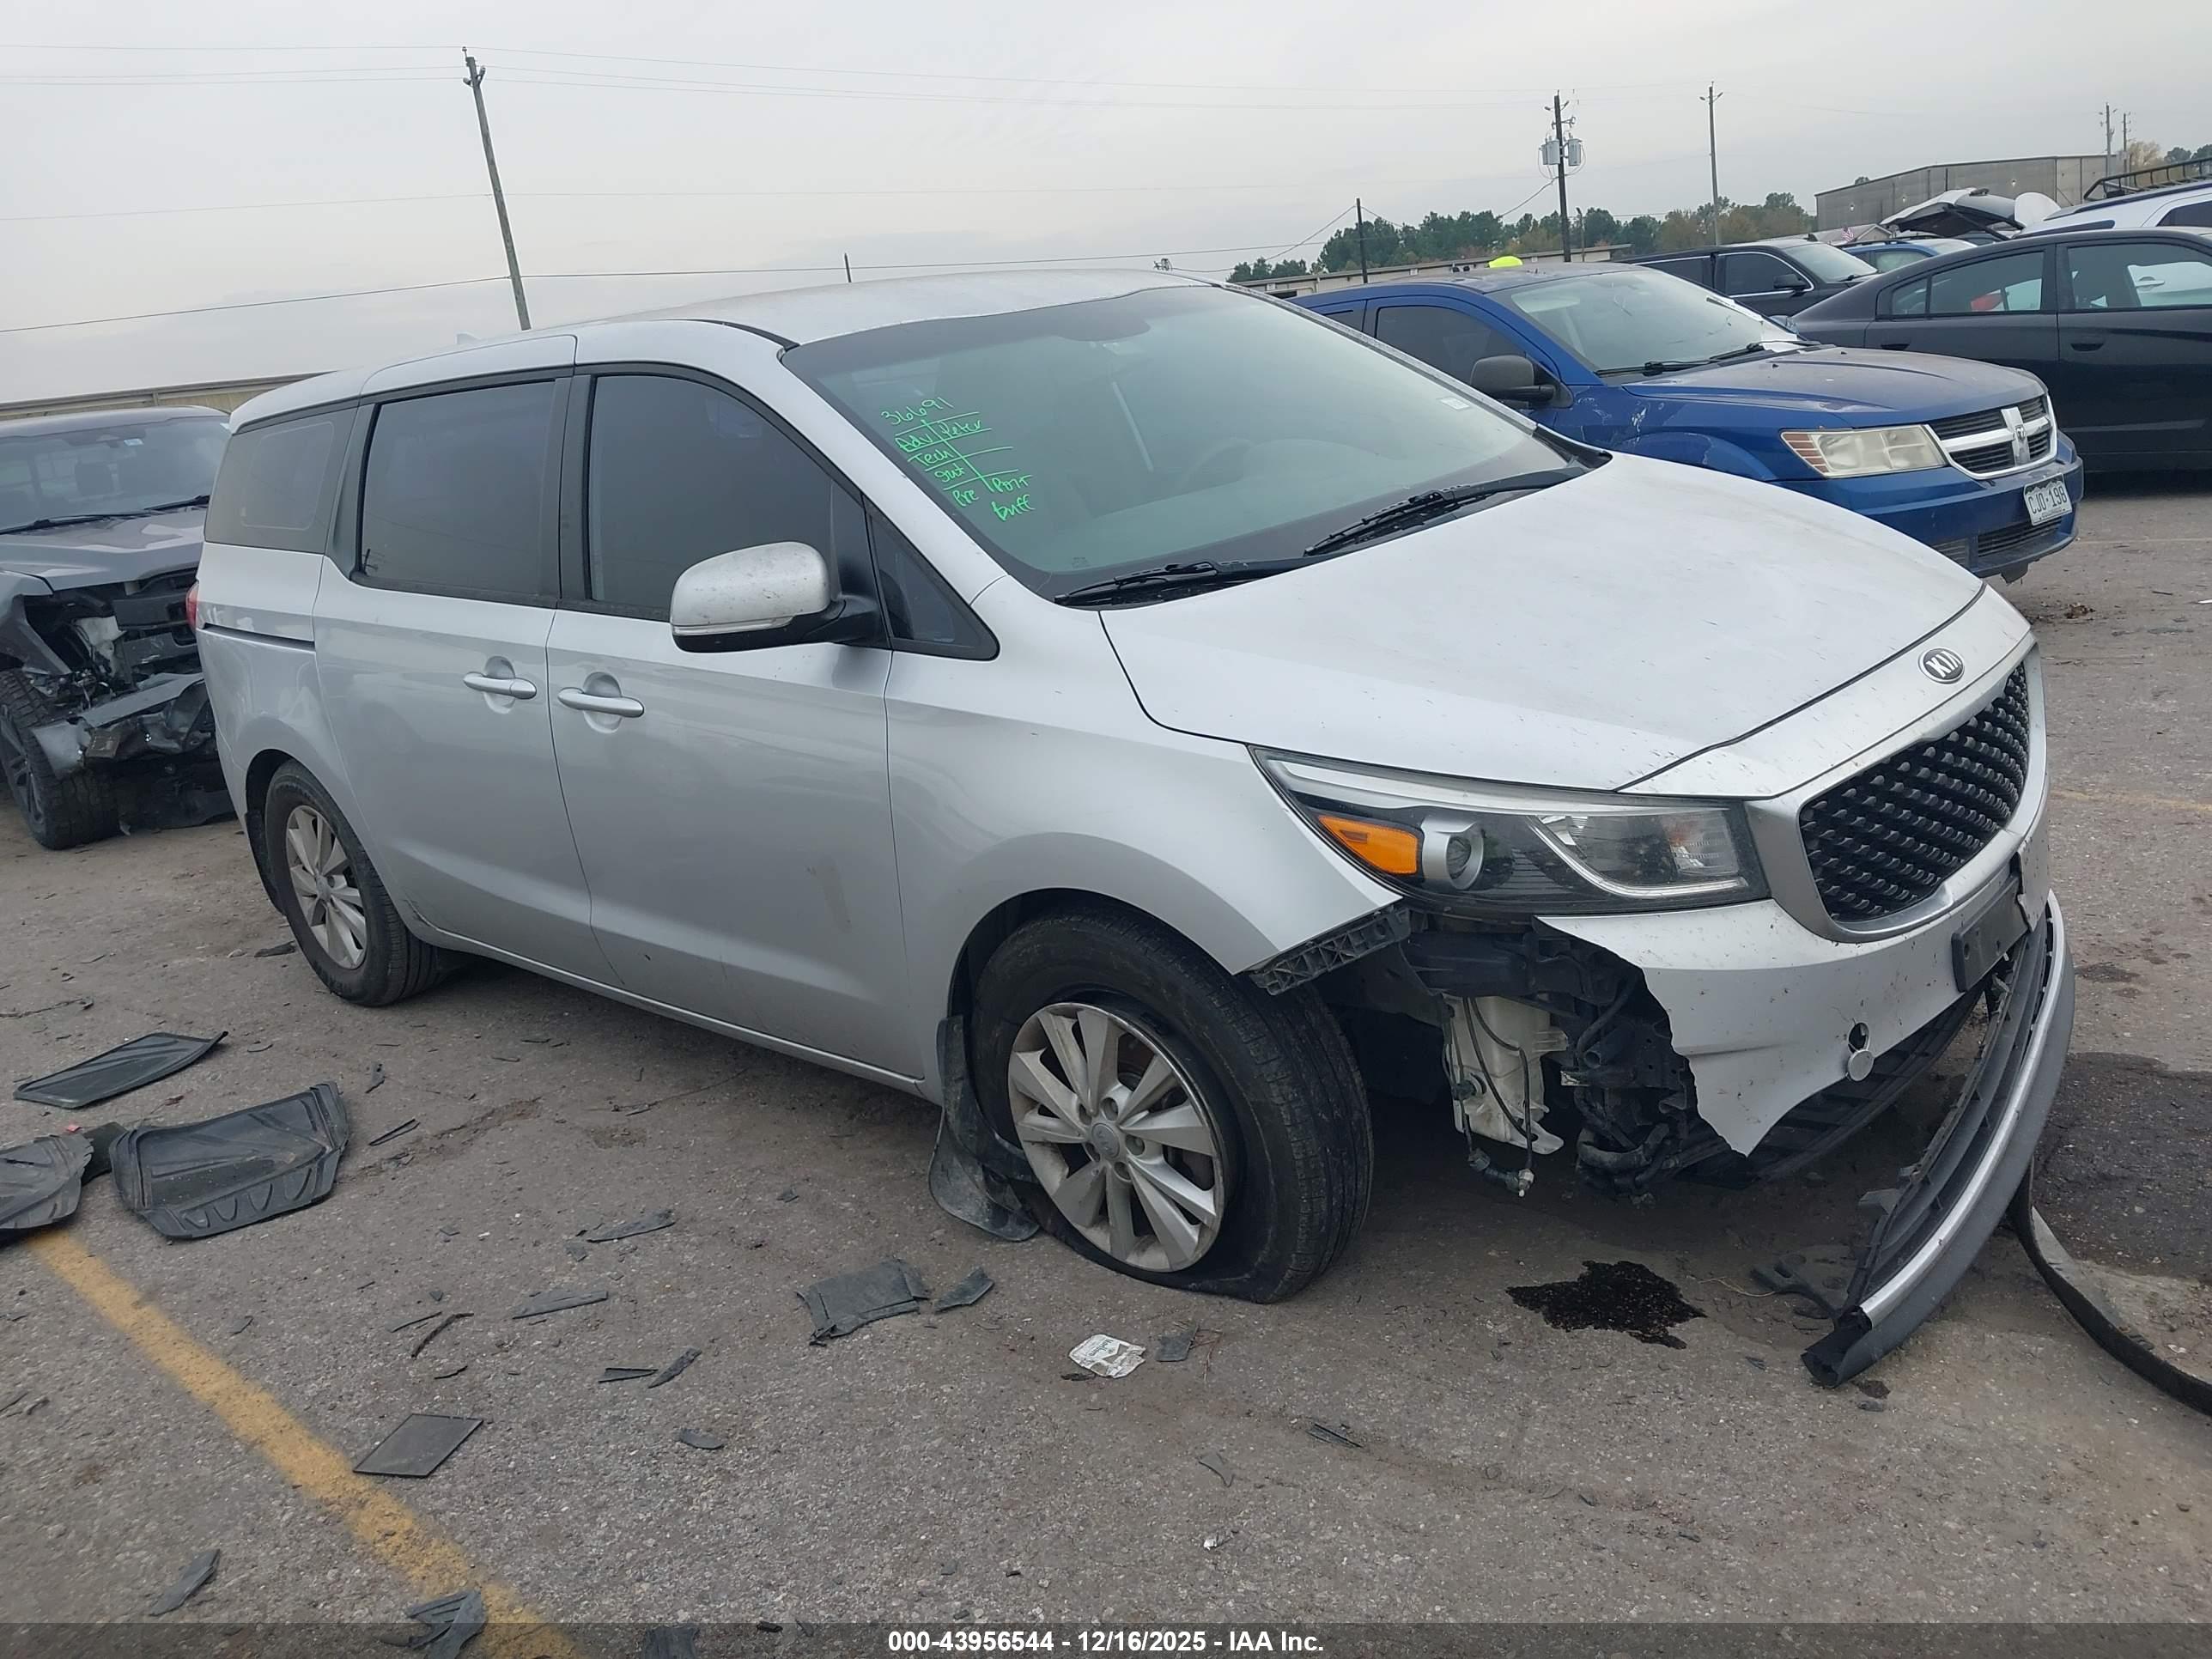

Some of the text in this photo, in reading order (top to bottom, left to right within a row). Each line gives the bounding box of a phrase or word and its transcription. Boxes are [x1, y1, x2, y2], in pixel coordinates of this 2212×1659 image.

[881, 397, 955, 425] 36691
[907, 448, 954, 466] Tech
[1925, 650, 1962, 678] KIA
